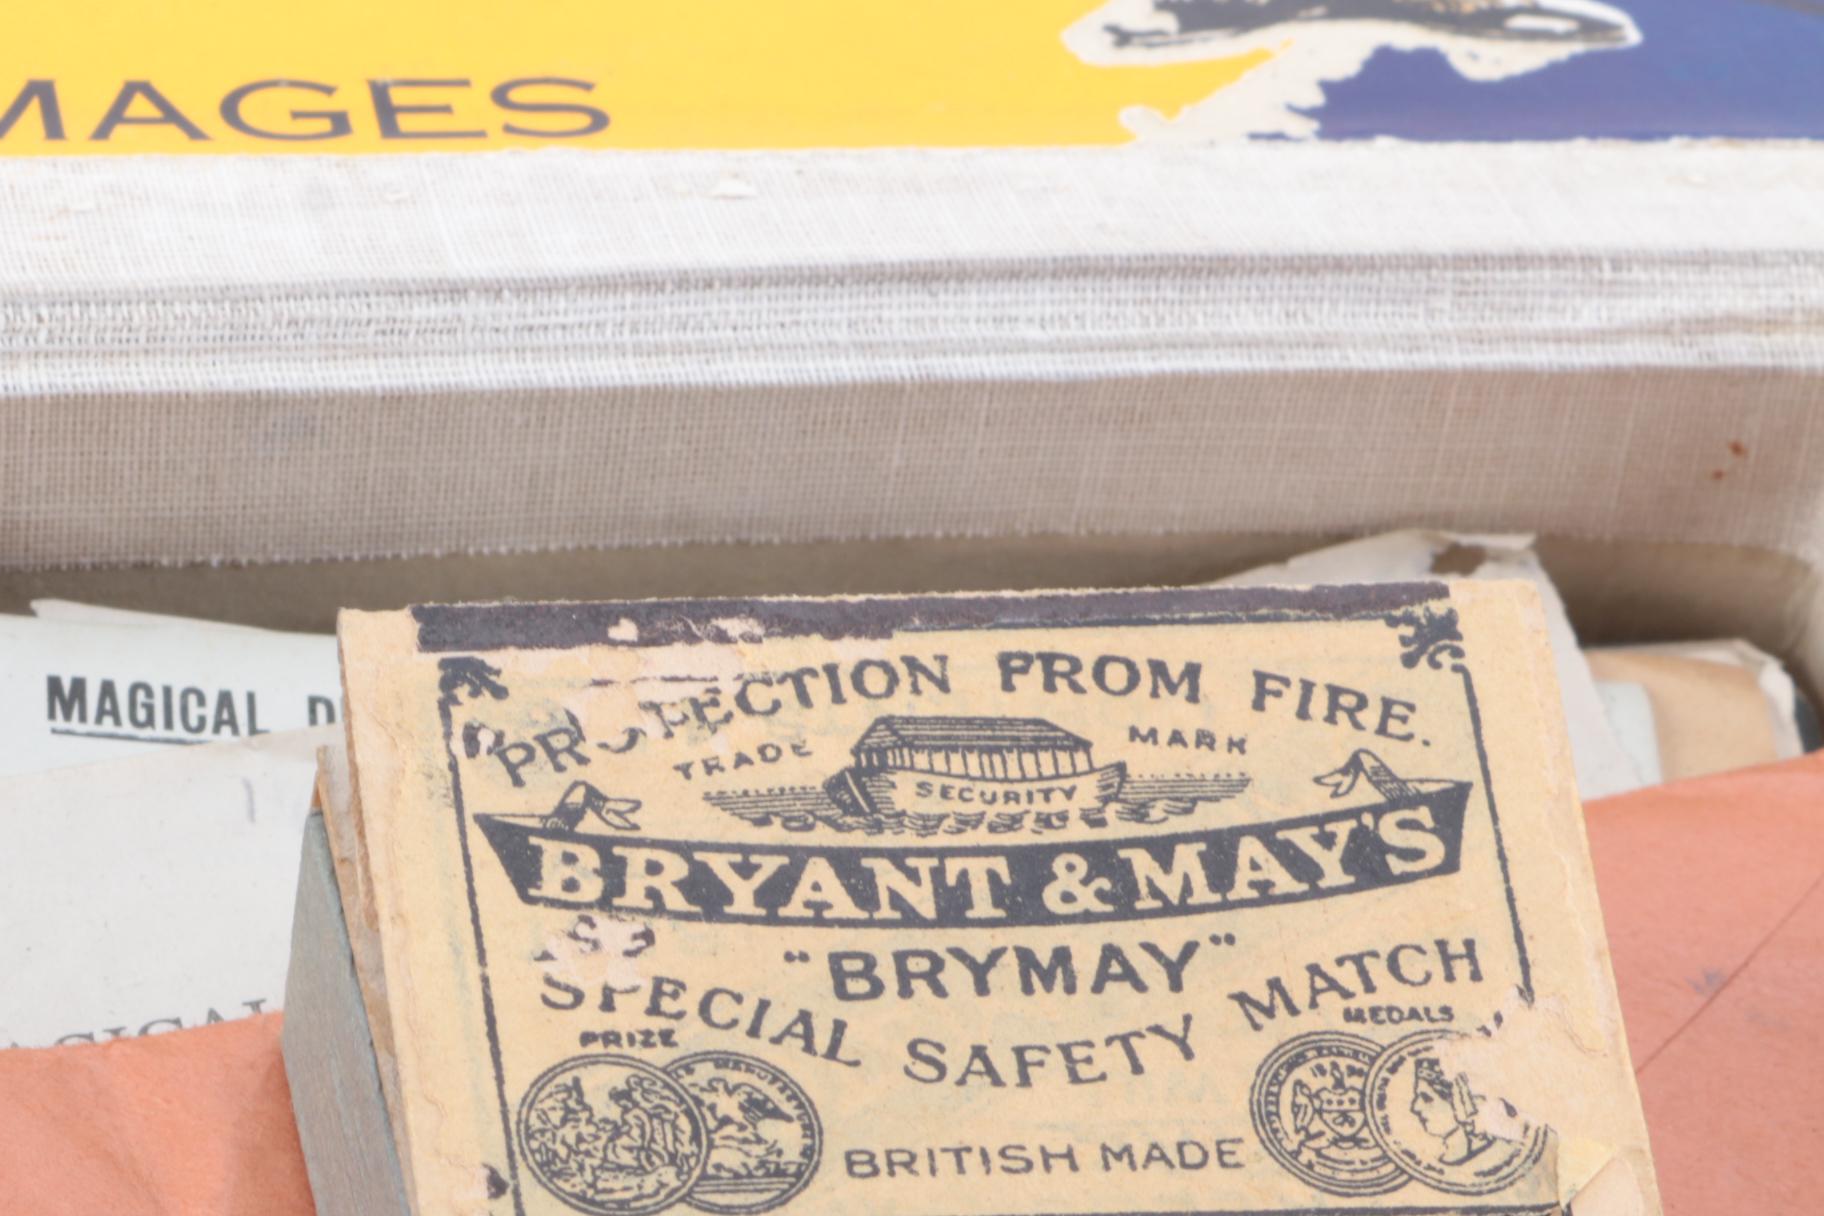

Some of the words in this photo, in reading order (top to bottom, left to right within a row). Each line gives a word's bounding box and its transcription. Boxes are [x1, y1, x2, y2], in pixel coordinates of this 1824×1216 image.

[45, 674, 271, 738] MAGICAL
[997, 650, 1205, 704] FROM
[1250, 668, 1432, 748] FIRE.
[673, 742, 814, 781] TRADE
[1128, 724, 1249, 754] MARK
[915, 780, 1079, 807] SECURITY
[528, 840, 1011, 919] BRYANT
[578, 1028, 679, 1049] PRIZE
[902, 1013, 1196, 1089] SAFETY
[1228, 937, 1484, 1032] MATCH
[1342, 1004, 1455, 1025] MEDALS
[842, 1143, 1078, 1180] BRITISH
[1101, 1137, 1246, 1173] MADE
